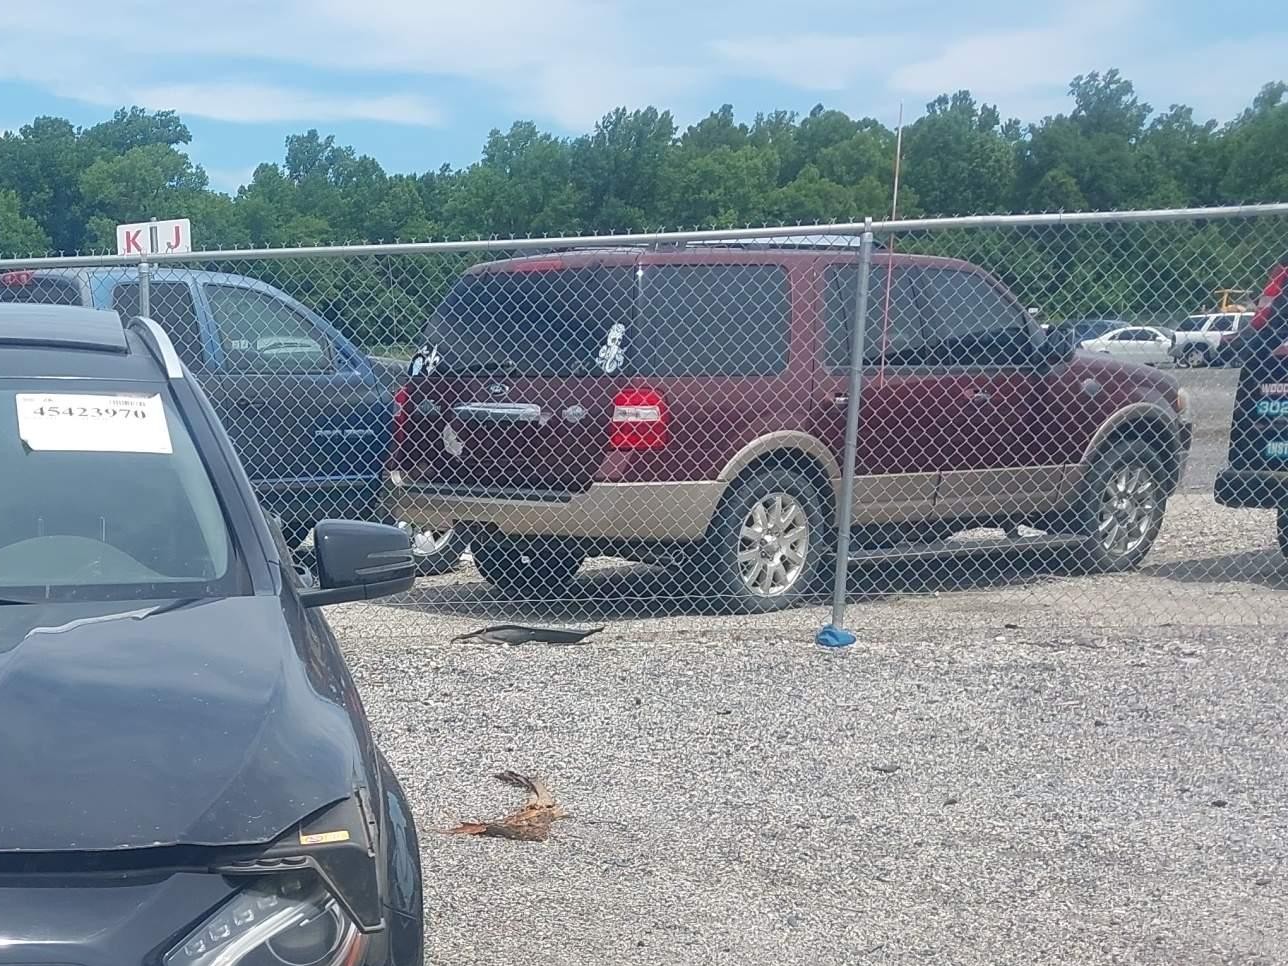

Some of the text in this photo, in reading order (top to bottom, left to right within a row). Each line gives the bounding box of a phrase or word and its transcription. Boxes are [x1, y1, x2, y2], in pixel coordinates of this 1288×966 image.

[125, 225, 181, 254] K J
[32, 406, 147, 419] 45423970
